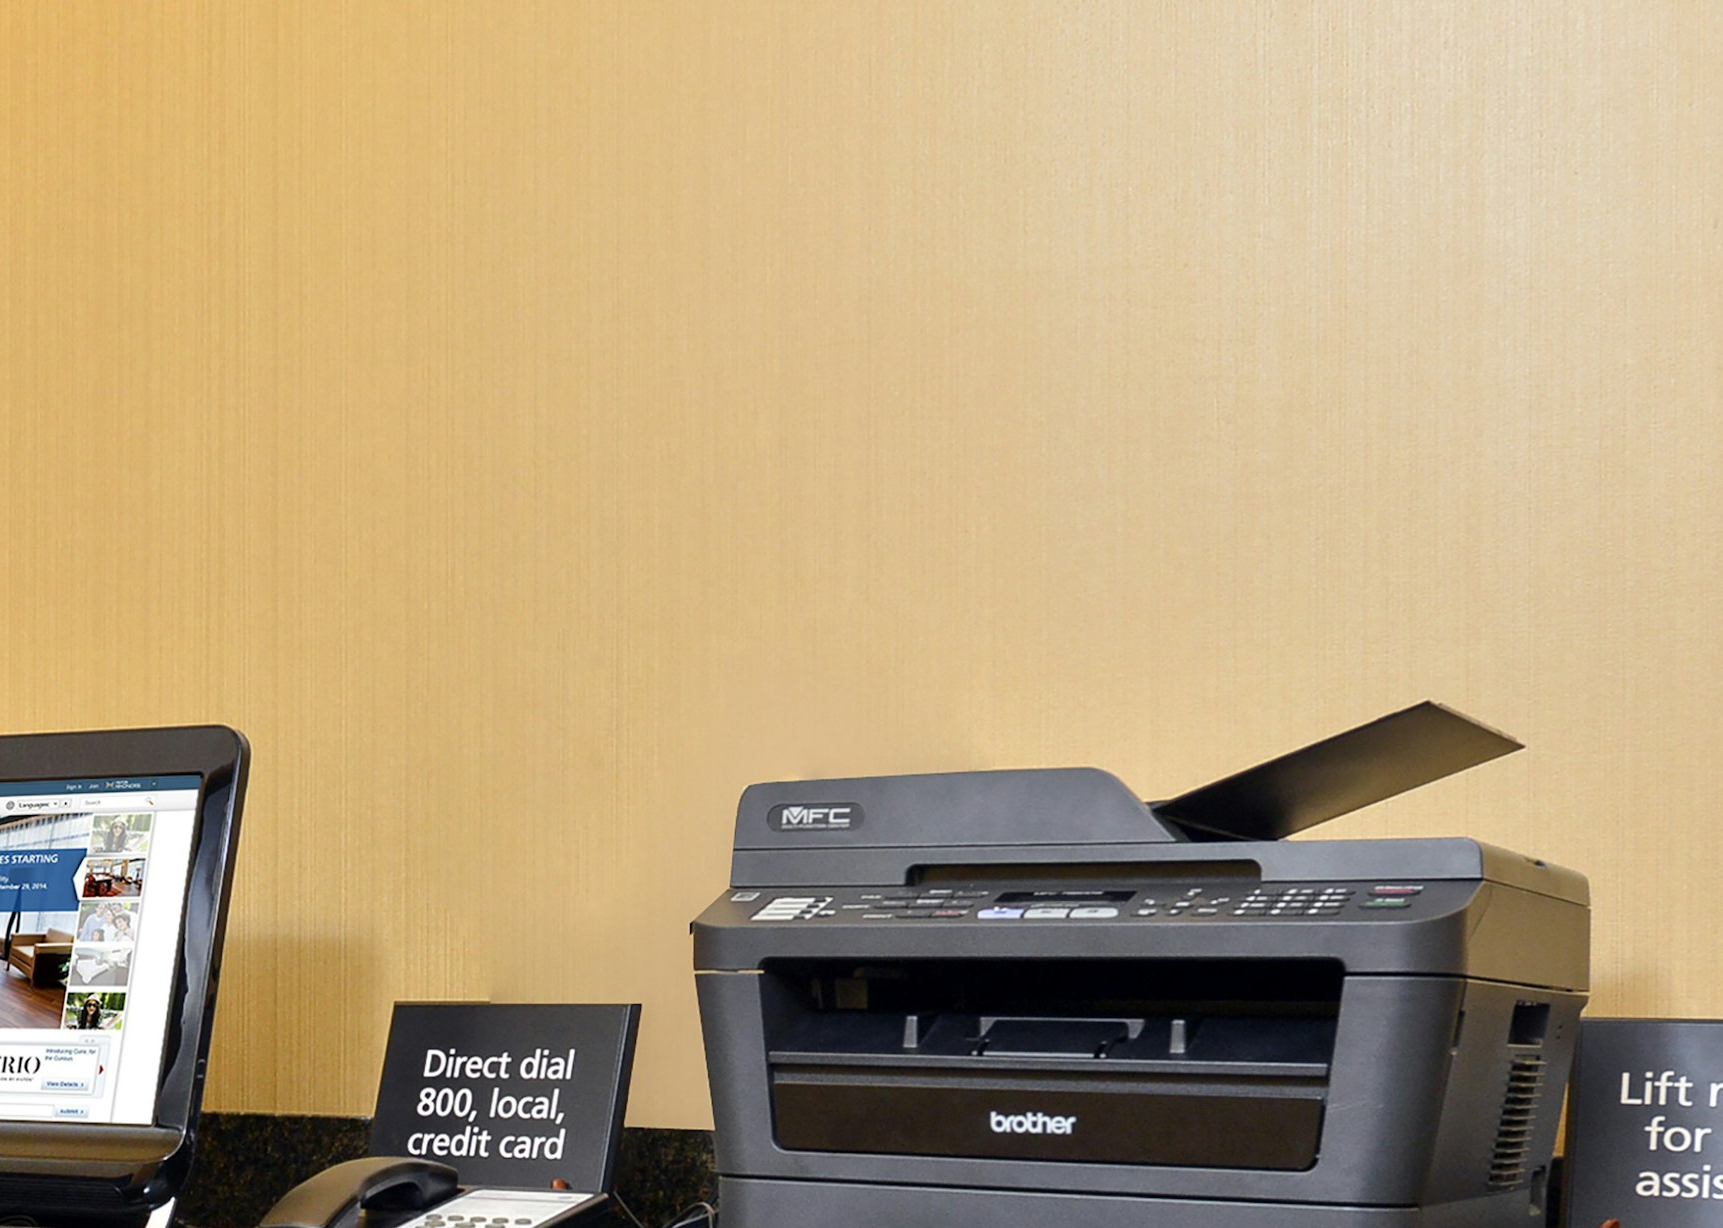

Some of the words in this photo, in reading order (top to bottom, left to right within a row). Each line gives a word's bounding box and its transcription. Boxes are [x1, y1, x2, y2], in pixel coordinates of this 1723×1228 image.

[781, 806, 851, 824] MFC
[11, 854, 59, 864] STARTING
[423, 1048, 512, 1079] Direct
[519, 1048, 575, 1080] dial
[1620, 1071, 1693, 1107] Lift
[417, 1087, 478, 1122] 800,
[489, 1087, 565, 1125] local,
[989, 1111, 1077, 1134] brother
[407, 1126, 491, 1157] credit
[499, 1128, 566, 1160] card
[1644, 1116, 1713, 1152] for
